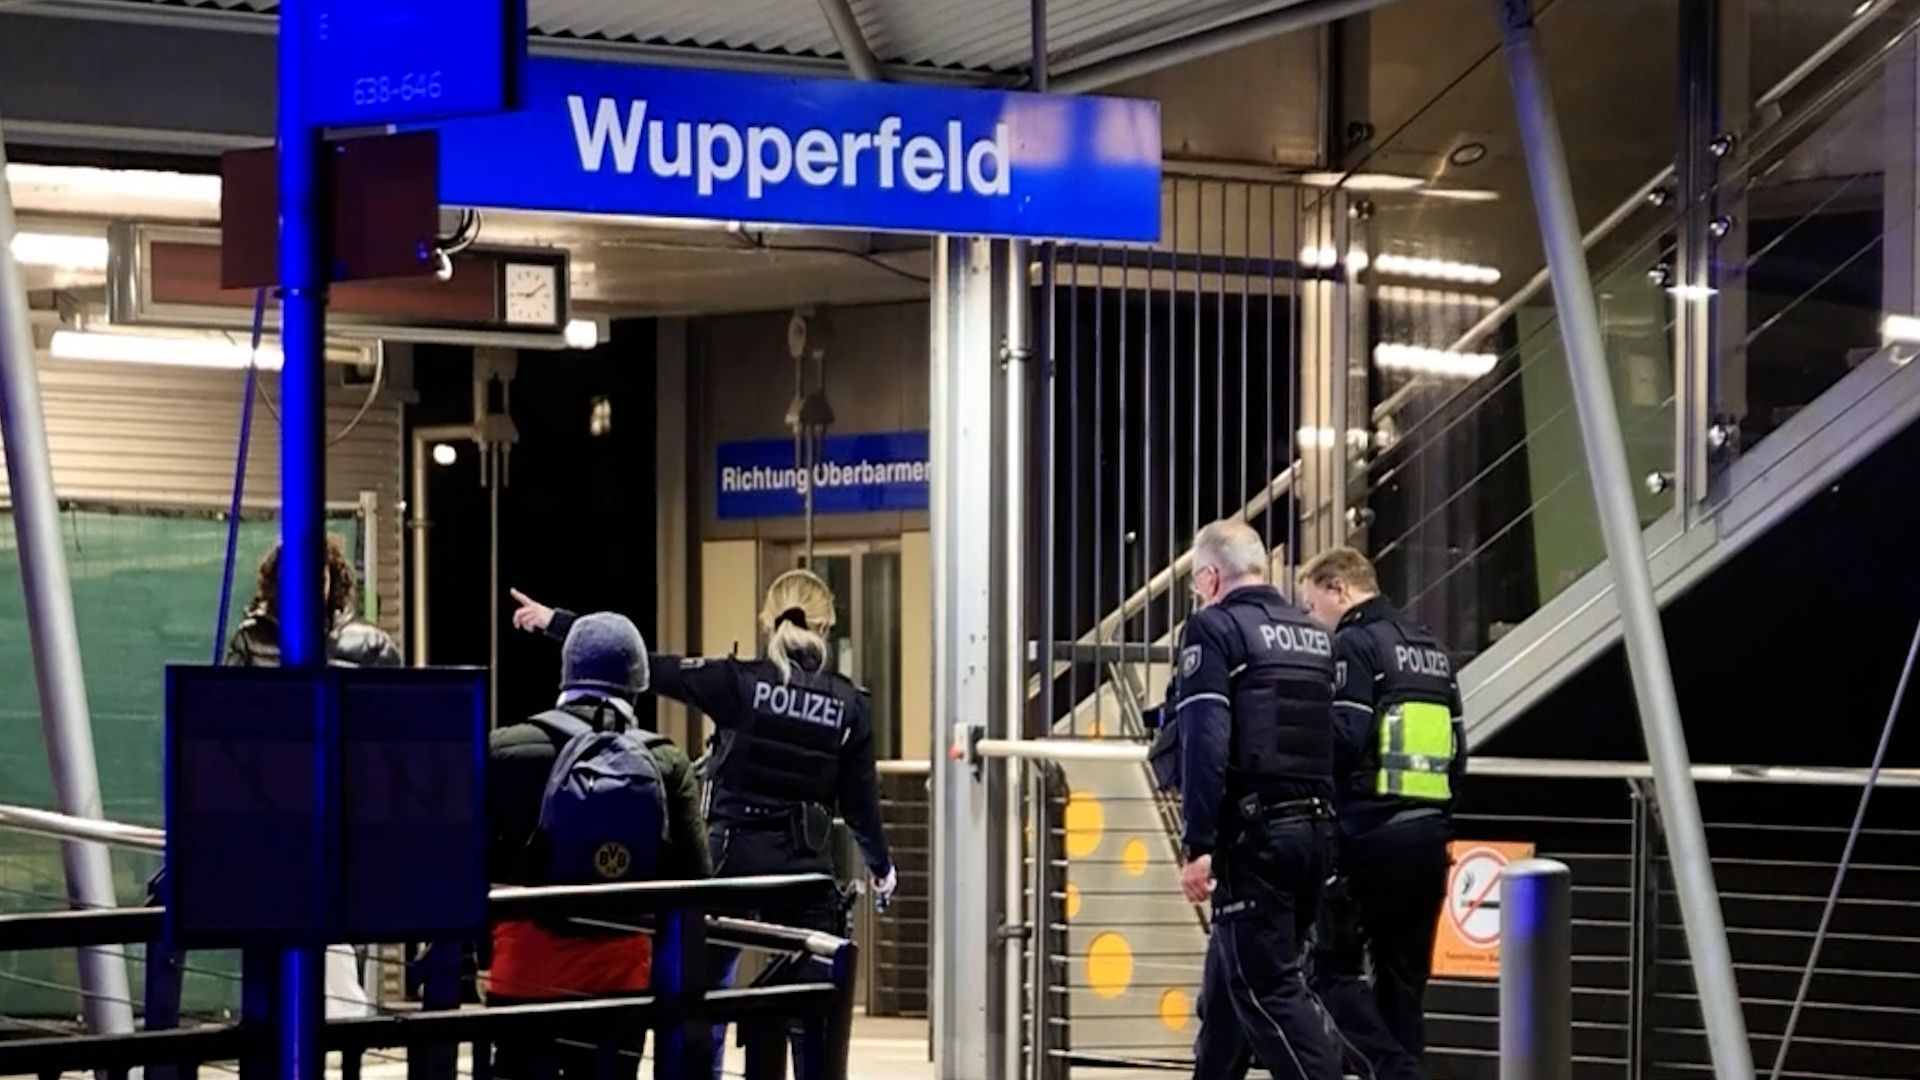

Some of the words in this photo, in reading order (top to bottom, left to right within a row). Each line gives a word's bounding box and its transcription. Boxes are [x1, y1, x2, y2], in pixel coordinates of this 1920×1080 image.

[353, 70, 443, 105] 638-646
[567, 95, 1010, 197] Wupperfeld
[722, 466, 808, 493] Richtung
[1260, 624, 1331, 657] POLIZEI
[1395, 645, 1450, 678] POLIZEI
[752, 681, 846, 728] POLIZEI
[599, 846, 627, 867] BVB
